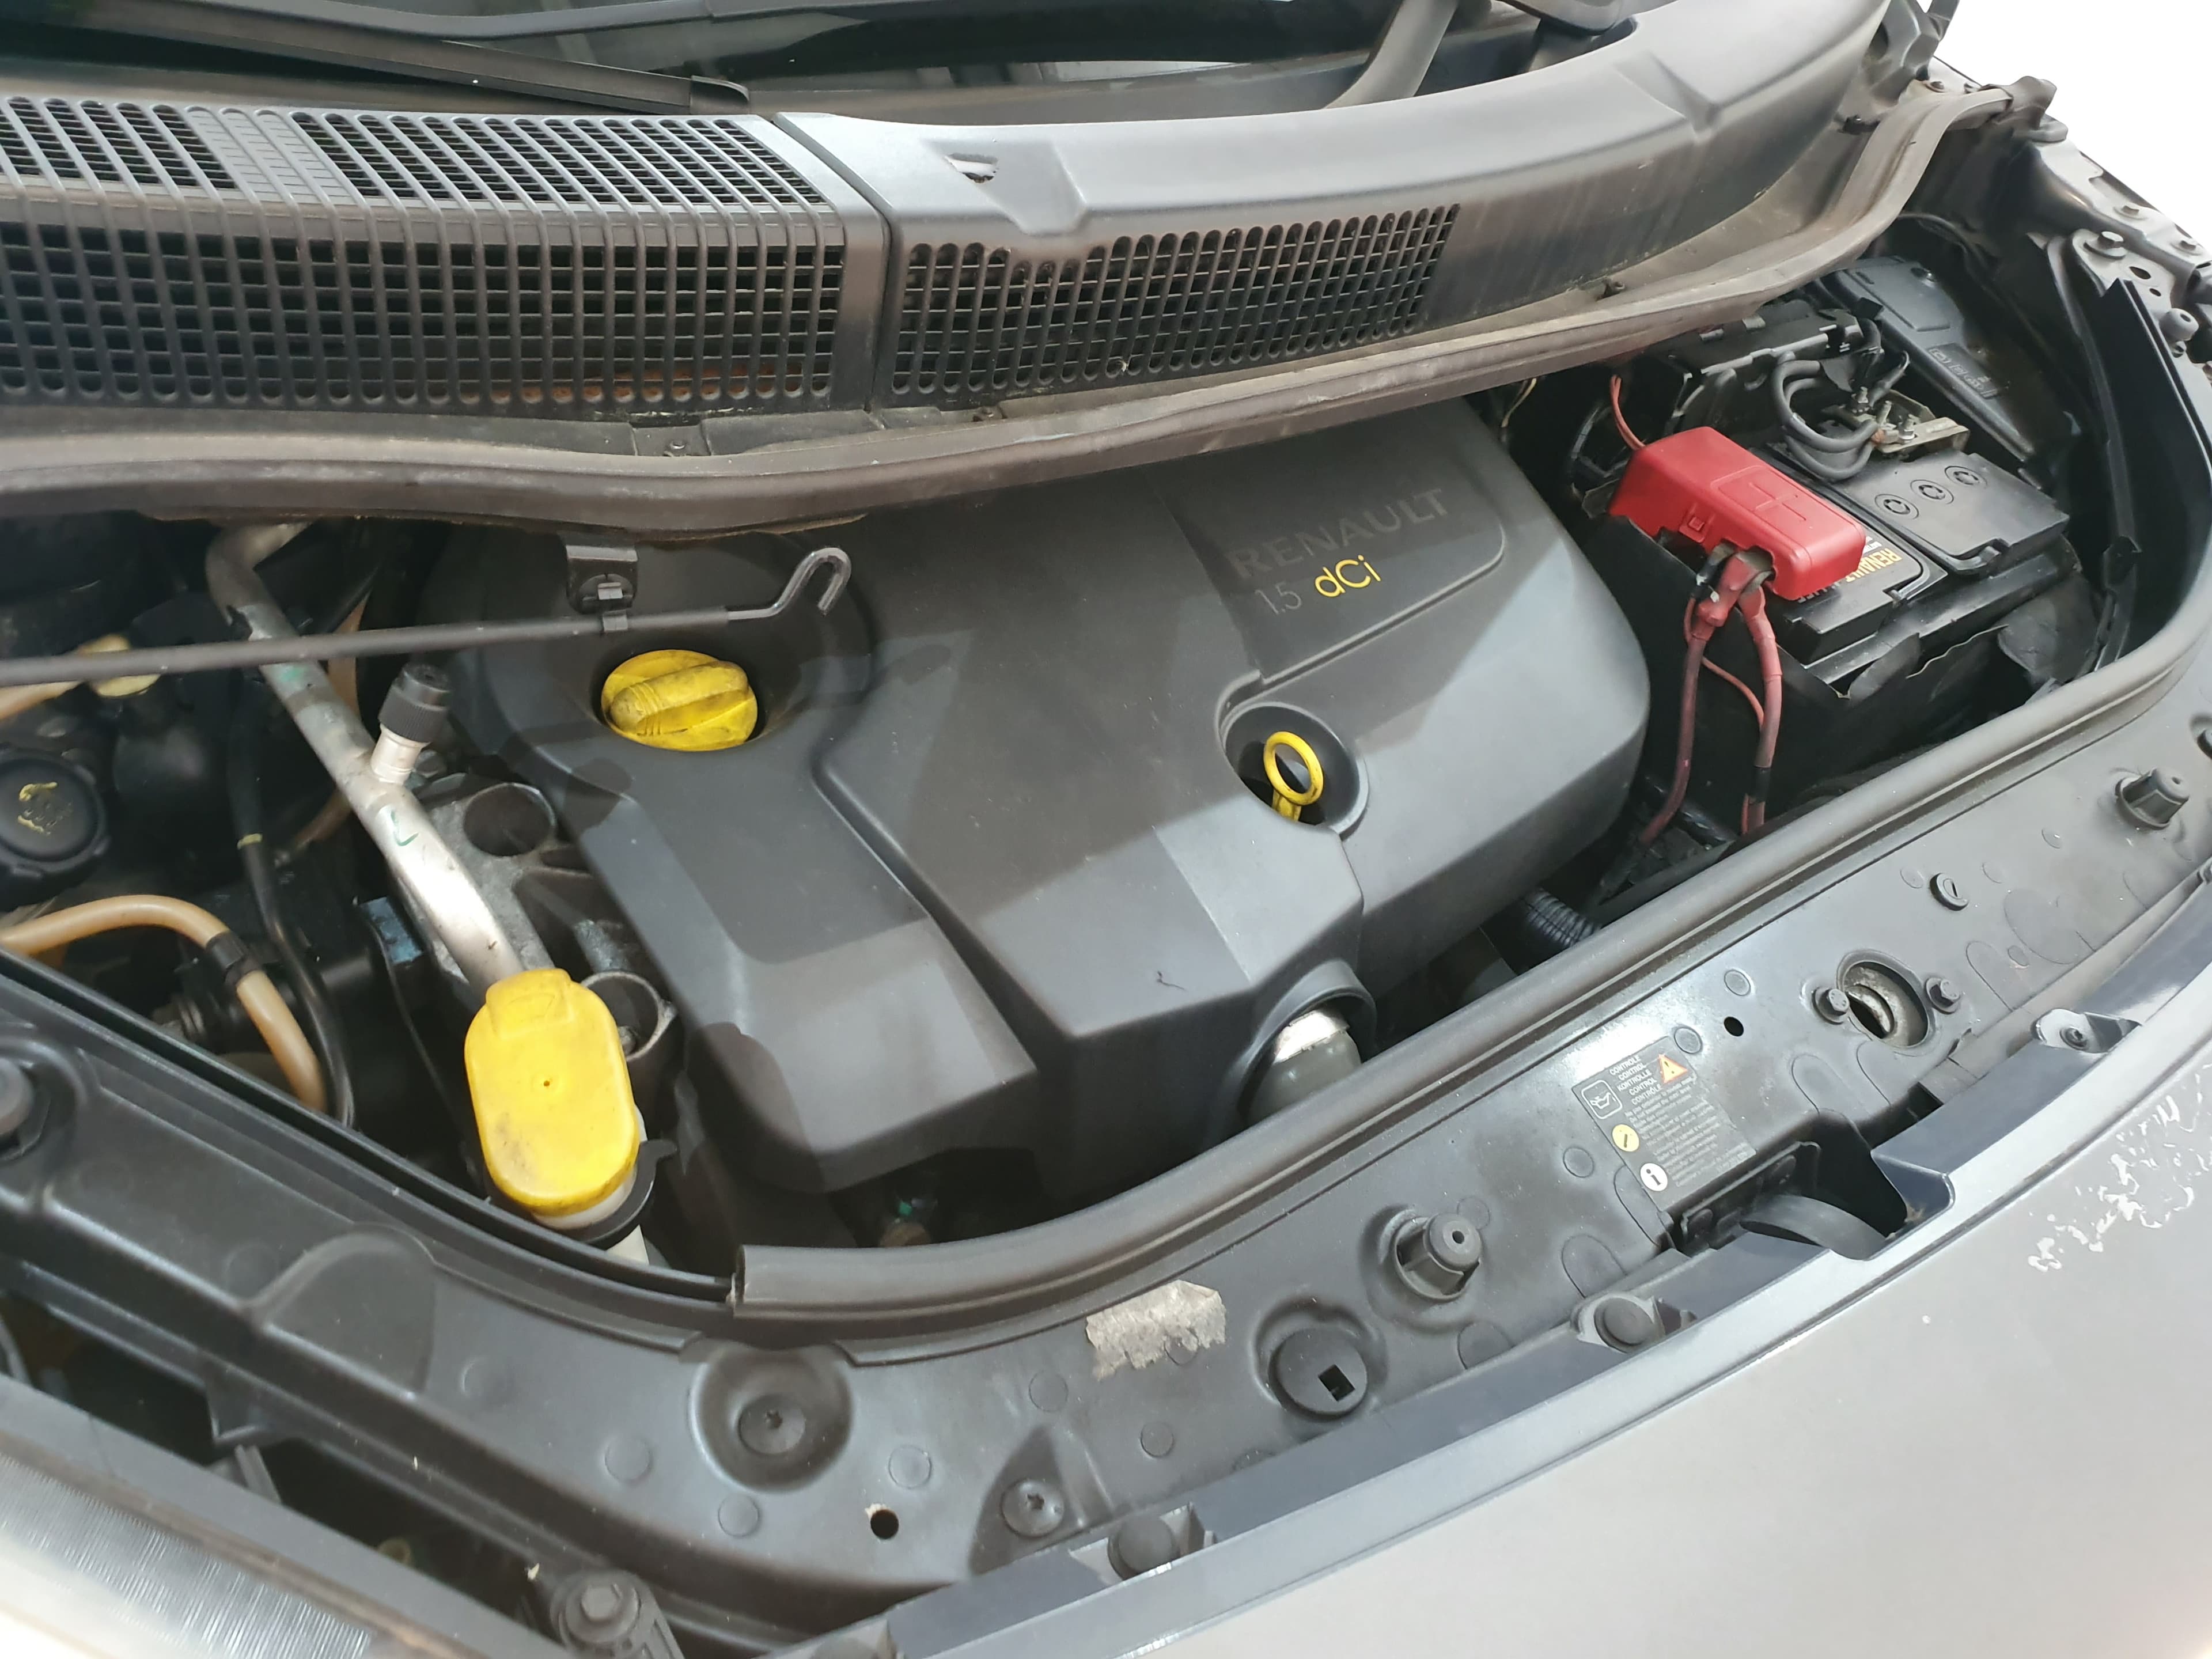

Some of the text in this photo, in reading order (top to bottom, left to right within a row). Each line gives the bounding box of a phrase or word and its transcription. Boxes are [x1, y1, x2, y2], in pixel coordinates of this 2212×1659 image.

[1225, 488, 1448, 580] RENAULT
[1255, 554, 1381, 615] 1.5 dCi
[1609, 1055, 1641, 1075] CONTROLE
[1618, 1063, 1646, 1081] CONTROL
[1616, 1069, 1652, 1092] KONTROLLE
[1629, 1077, 1657, 1096] CONTROL
